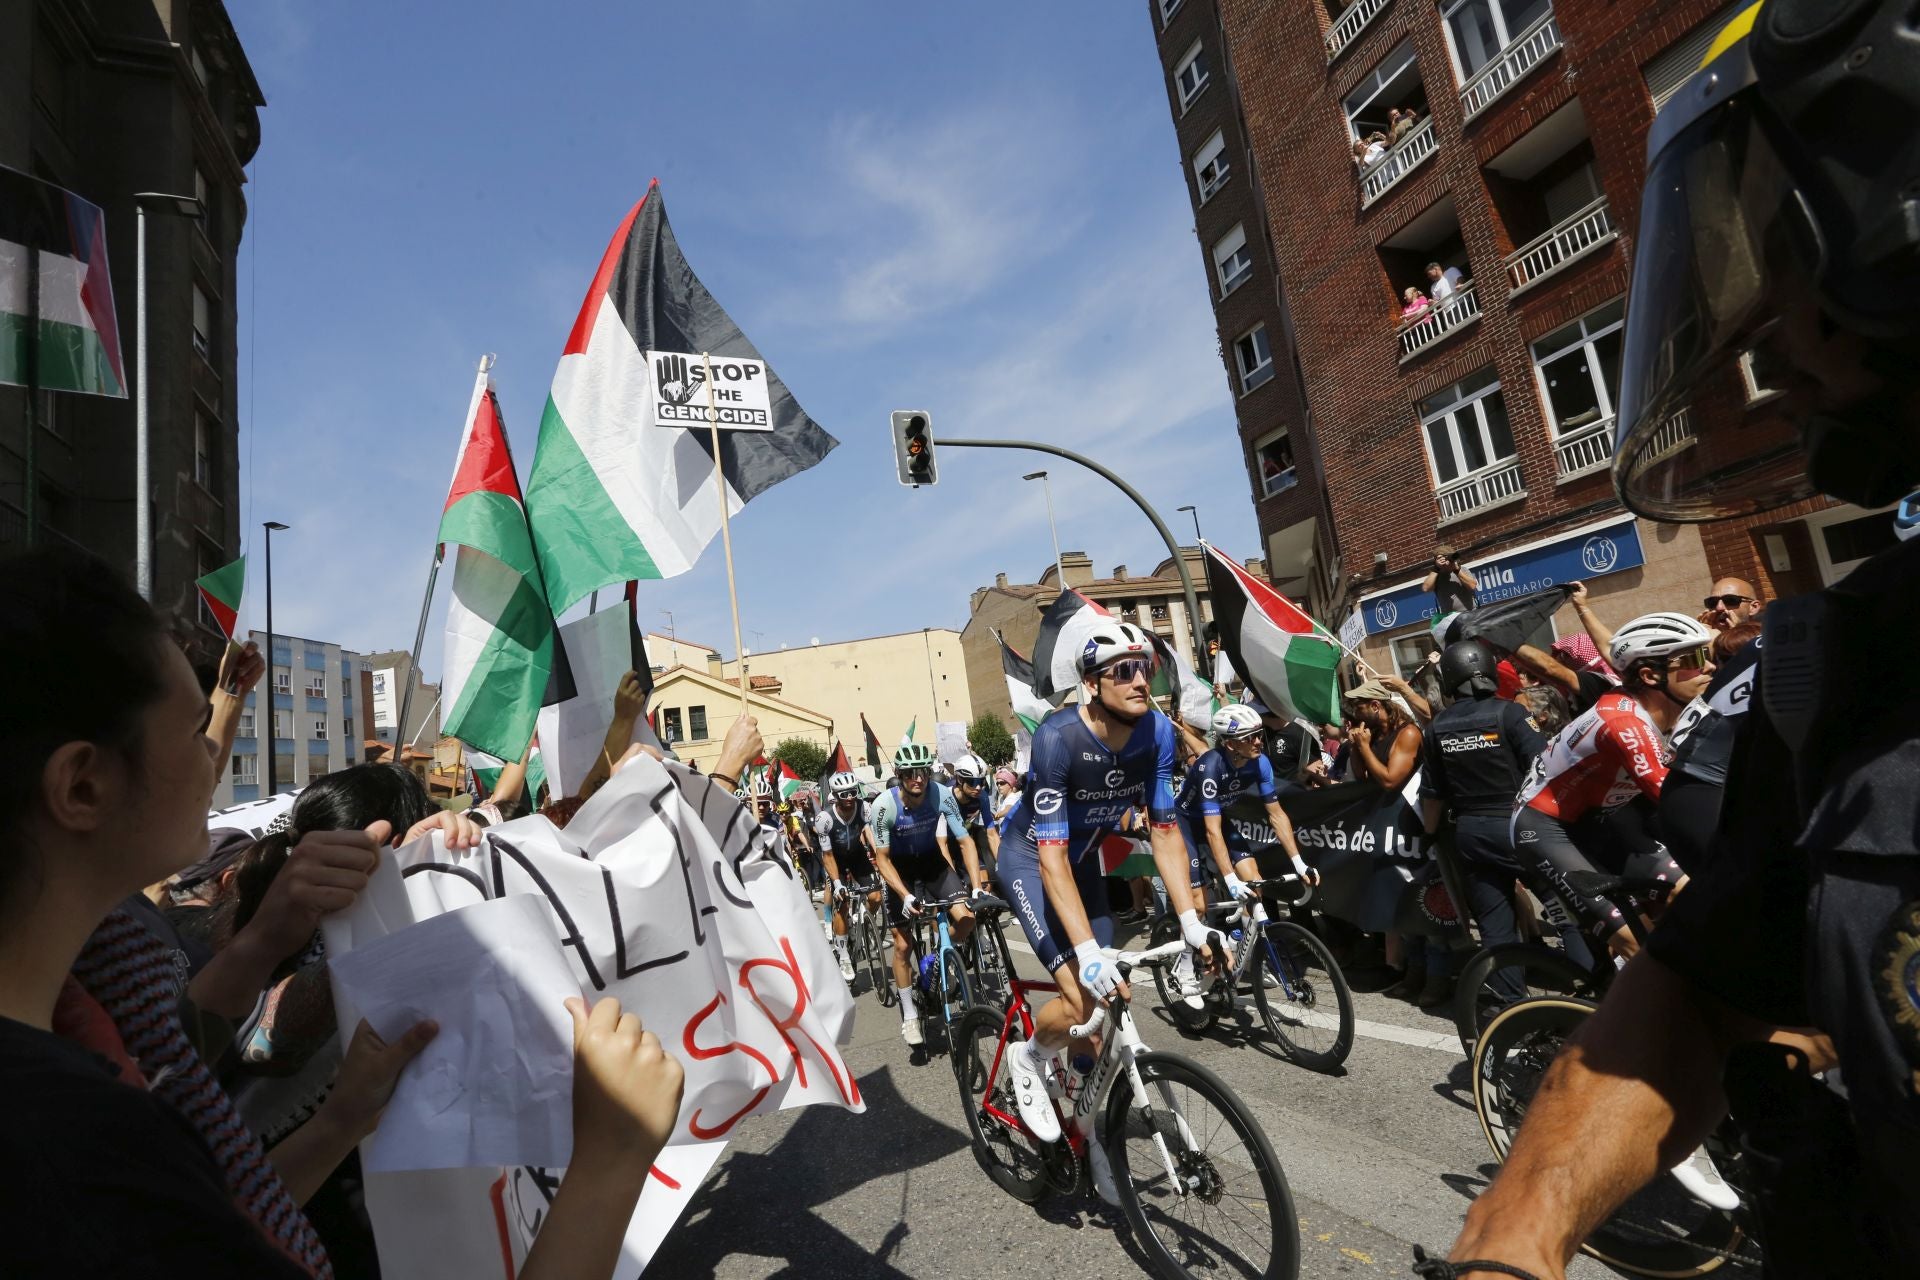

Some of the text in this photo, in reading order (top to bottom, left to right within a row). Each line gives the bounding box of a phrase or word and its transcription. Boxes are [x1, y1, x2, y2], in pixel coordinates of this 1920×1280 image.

[689, 363, 761, 382] STOP
[706, 388, 743, 402] THE
[659, 405, 767, 424] GENOCIDE
[1472, 565, 1515, 592] Villa
[1421, 606, 1441, 619] CE
[1614, 641, 1631, 660] uvex
[1440, 734, 1487, 747] POLICIA
[1443, 740, 1501, 754] NACIONAL
[1075, 781, 1146, 801] Groupama
[1086, 804, 1118, 817] FDJ
[1300, 820, 1347, 851] está
[1350, 824, 1376, 853] de
[1384, 825, 1437, 861] lu
[1536, 858, 1588, 912] FANTINI
[1012, 878, 1045, 941] Groupama
[1547, 900, 1569, 924] 184
